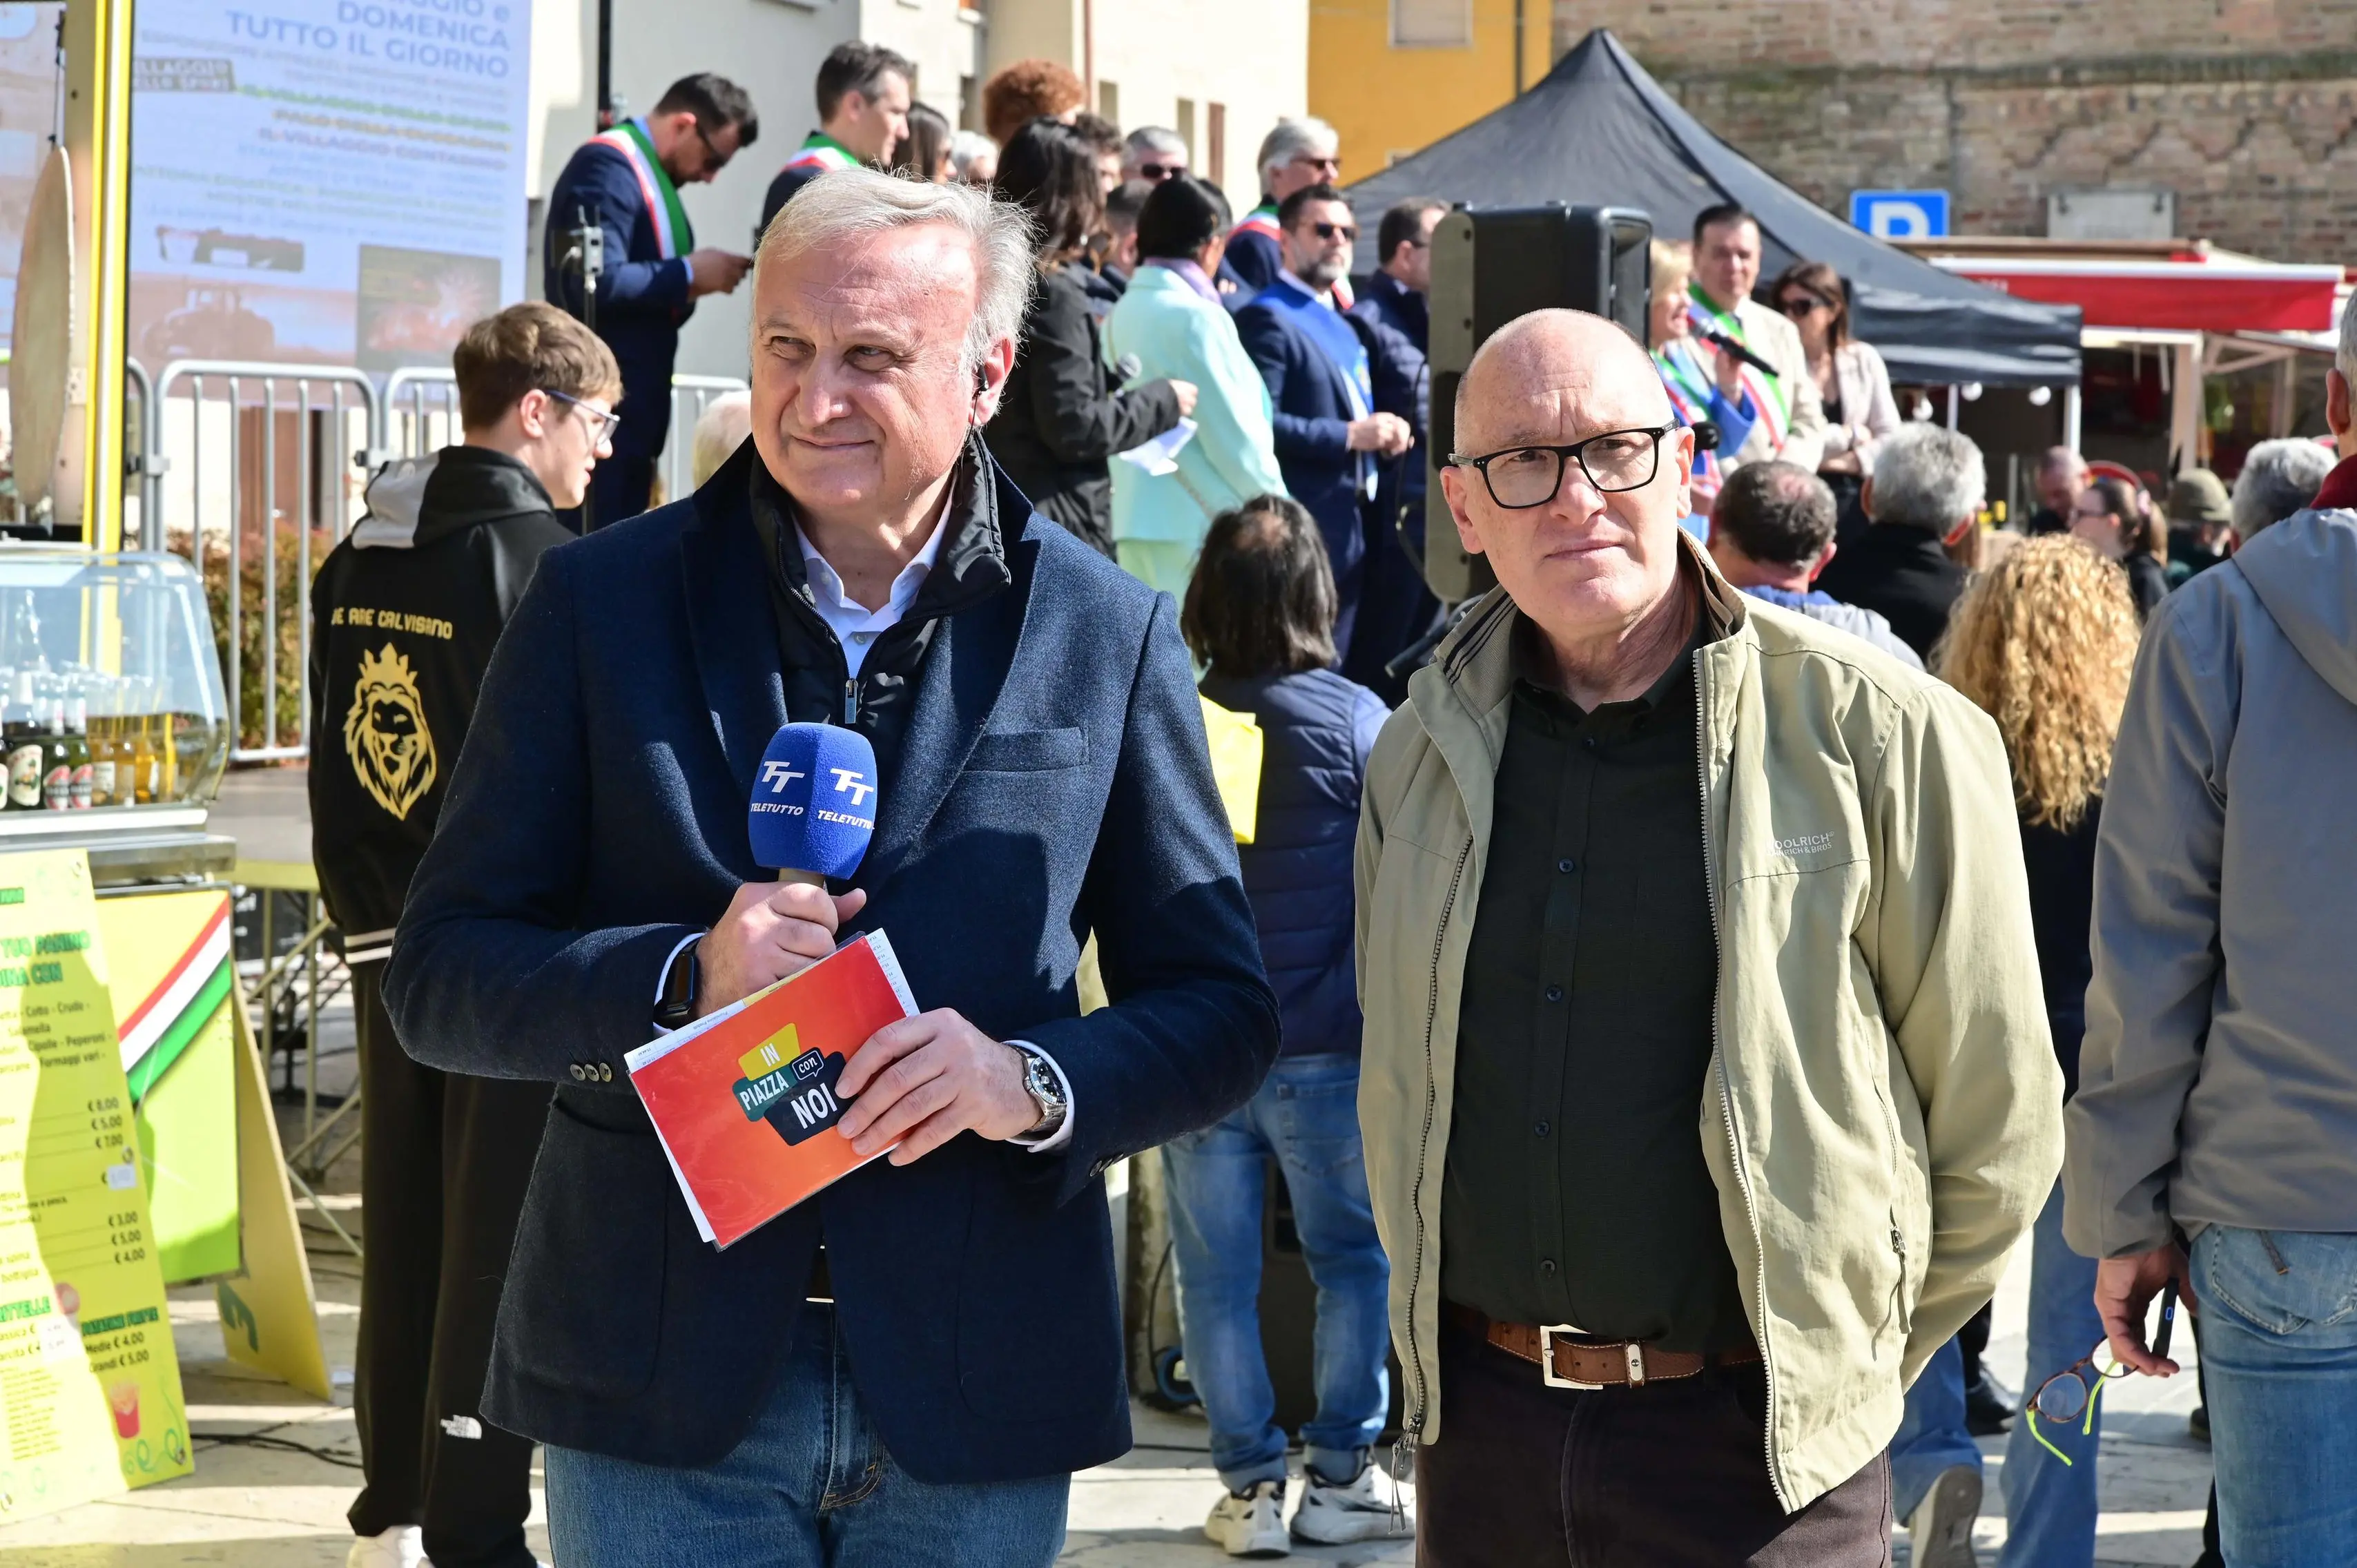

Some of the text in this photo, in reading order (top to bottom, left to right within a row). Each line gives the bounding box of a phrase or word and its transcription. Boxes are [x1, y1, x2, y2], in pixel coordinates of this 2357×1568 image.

[224, 9, 338, 50] TUTTO
[347, 30, 376, 56] IL
[385, 37, 510, 79] GIORNO
[337, 0, 510, 52] DOMENICA
[349, 608, 375, 626] ARE
[378, 610, 452, 639] CALVISANO
[750, 802, 804, 816] TELETUTTO
[31, 961, 63, 985] CON
[759, 1043, 781, 1067] IN
[739, 1056, 817, 1111] PIAZZA con
[790, 1082, 837, 1130] NOI
